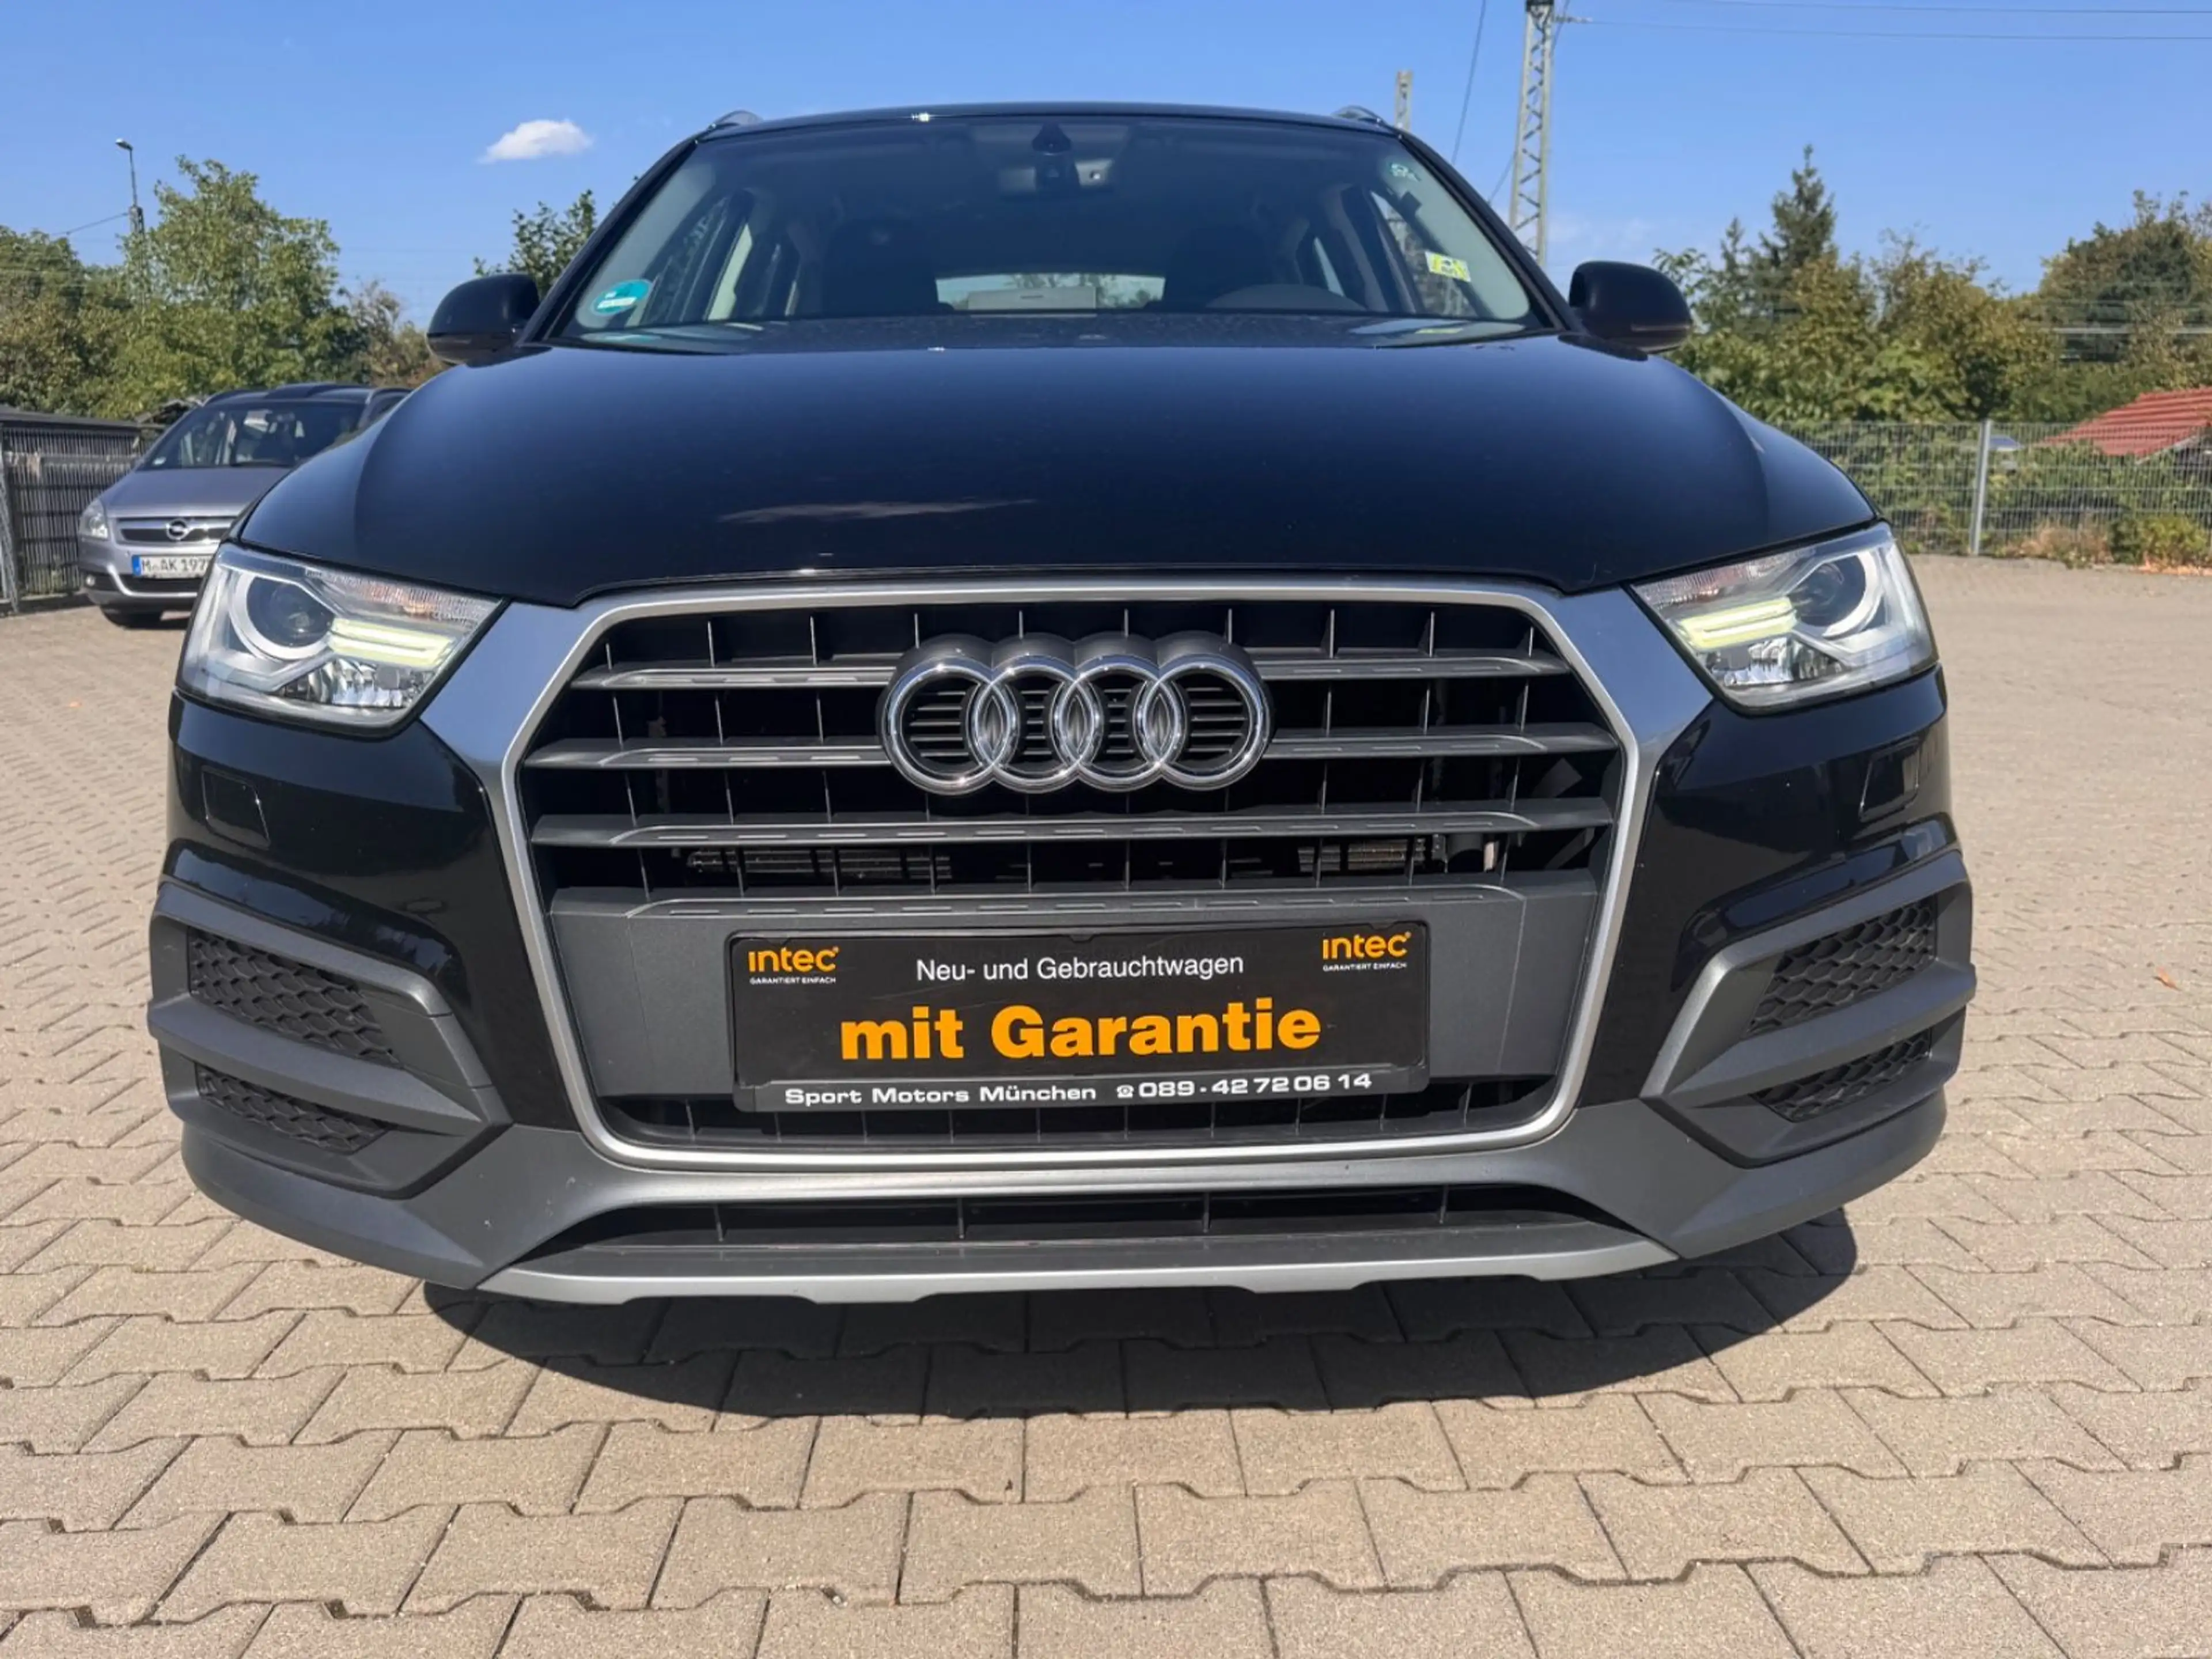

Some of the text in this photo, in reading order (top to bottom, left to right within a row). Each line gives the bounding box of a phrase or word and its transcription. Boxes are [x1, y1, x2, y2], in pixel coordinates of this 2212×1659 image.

[160, 558, 178, 571] AK
[1323, 933, 1408, 960] intec
[748, 946, 836, 972] intec
[916, 955, 1244, 981] Neu- und Gebrauchtwagen
[1323, 961, 1407, 972] GARANTIERT EINFACH
[749, 976, 836, 985] GARANTIERT EINFACH
[841, 997, 1321, 1060] mit Garantie
[785, 1088, 862, 1107] Sport
[872, 1088, 969, 1103] Motors
[980, 1085, 1096, 1101] München
